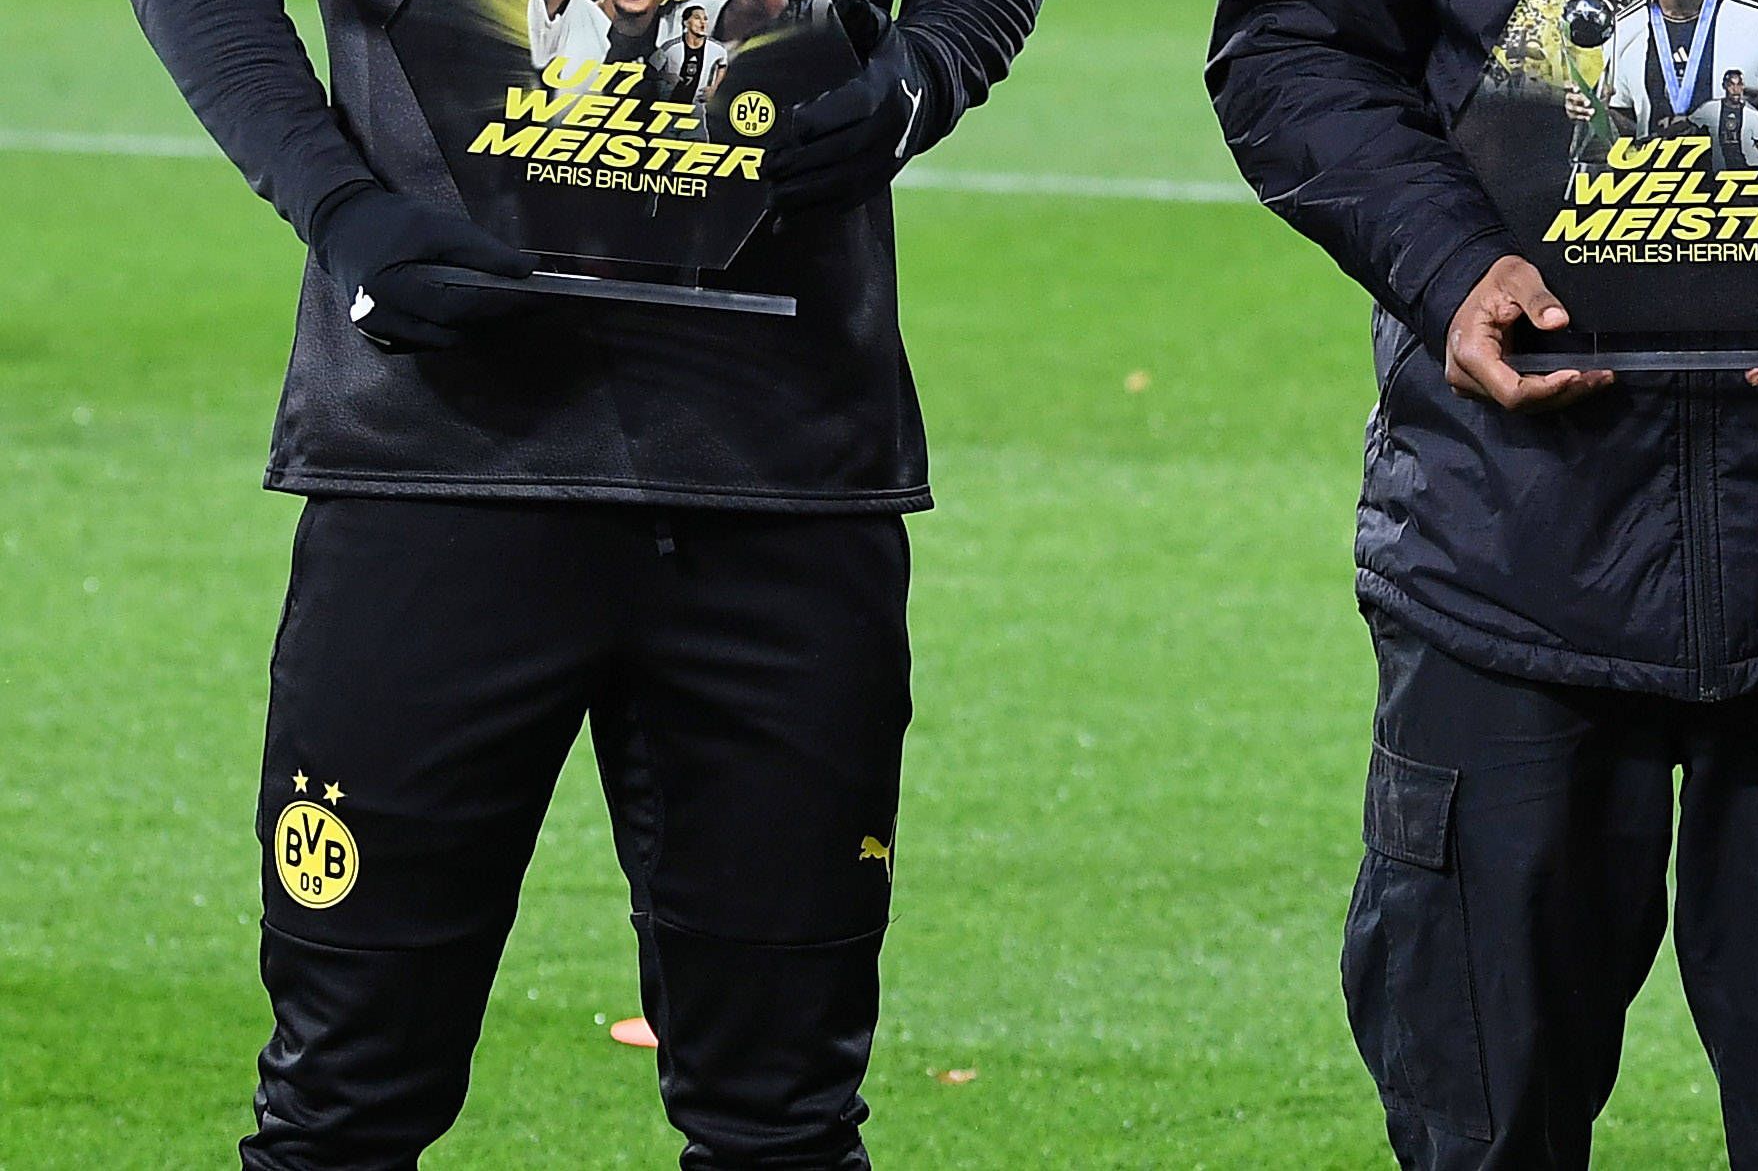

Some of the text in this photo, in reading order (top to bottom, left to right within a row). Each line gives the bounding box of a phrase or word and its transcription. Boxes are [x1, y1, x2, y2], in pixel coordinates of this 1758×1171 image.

[541, 56, 647, 95] U17
[505, 86, 700, 134] WELT-
[736, 96, 770, 123] BVB
[745, 121, 758, 132] 09
[467, 122, 766, 180] MEISTER
[1606, 135, 1712, 169] U17
[526, 162, 708, 198] PARIS BRUNNER
[1563, 243, 1673, 265] CHARLES
[286, 812, 346, 879] BVB
[300, 872, 323, 895] 09
